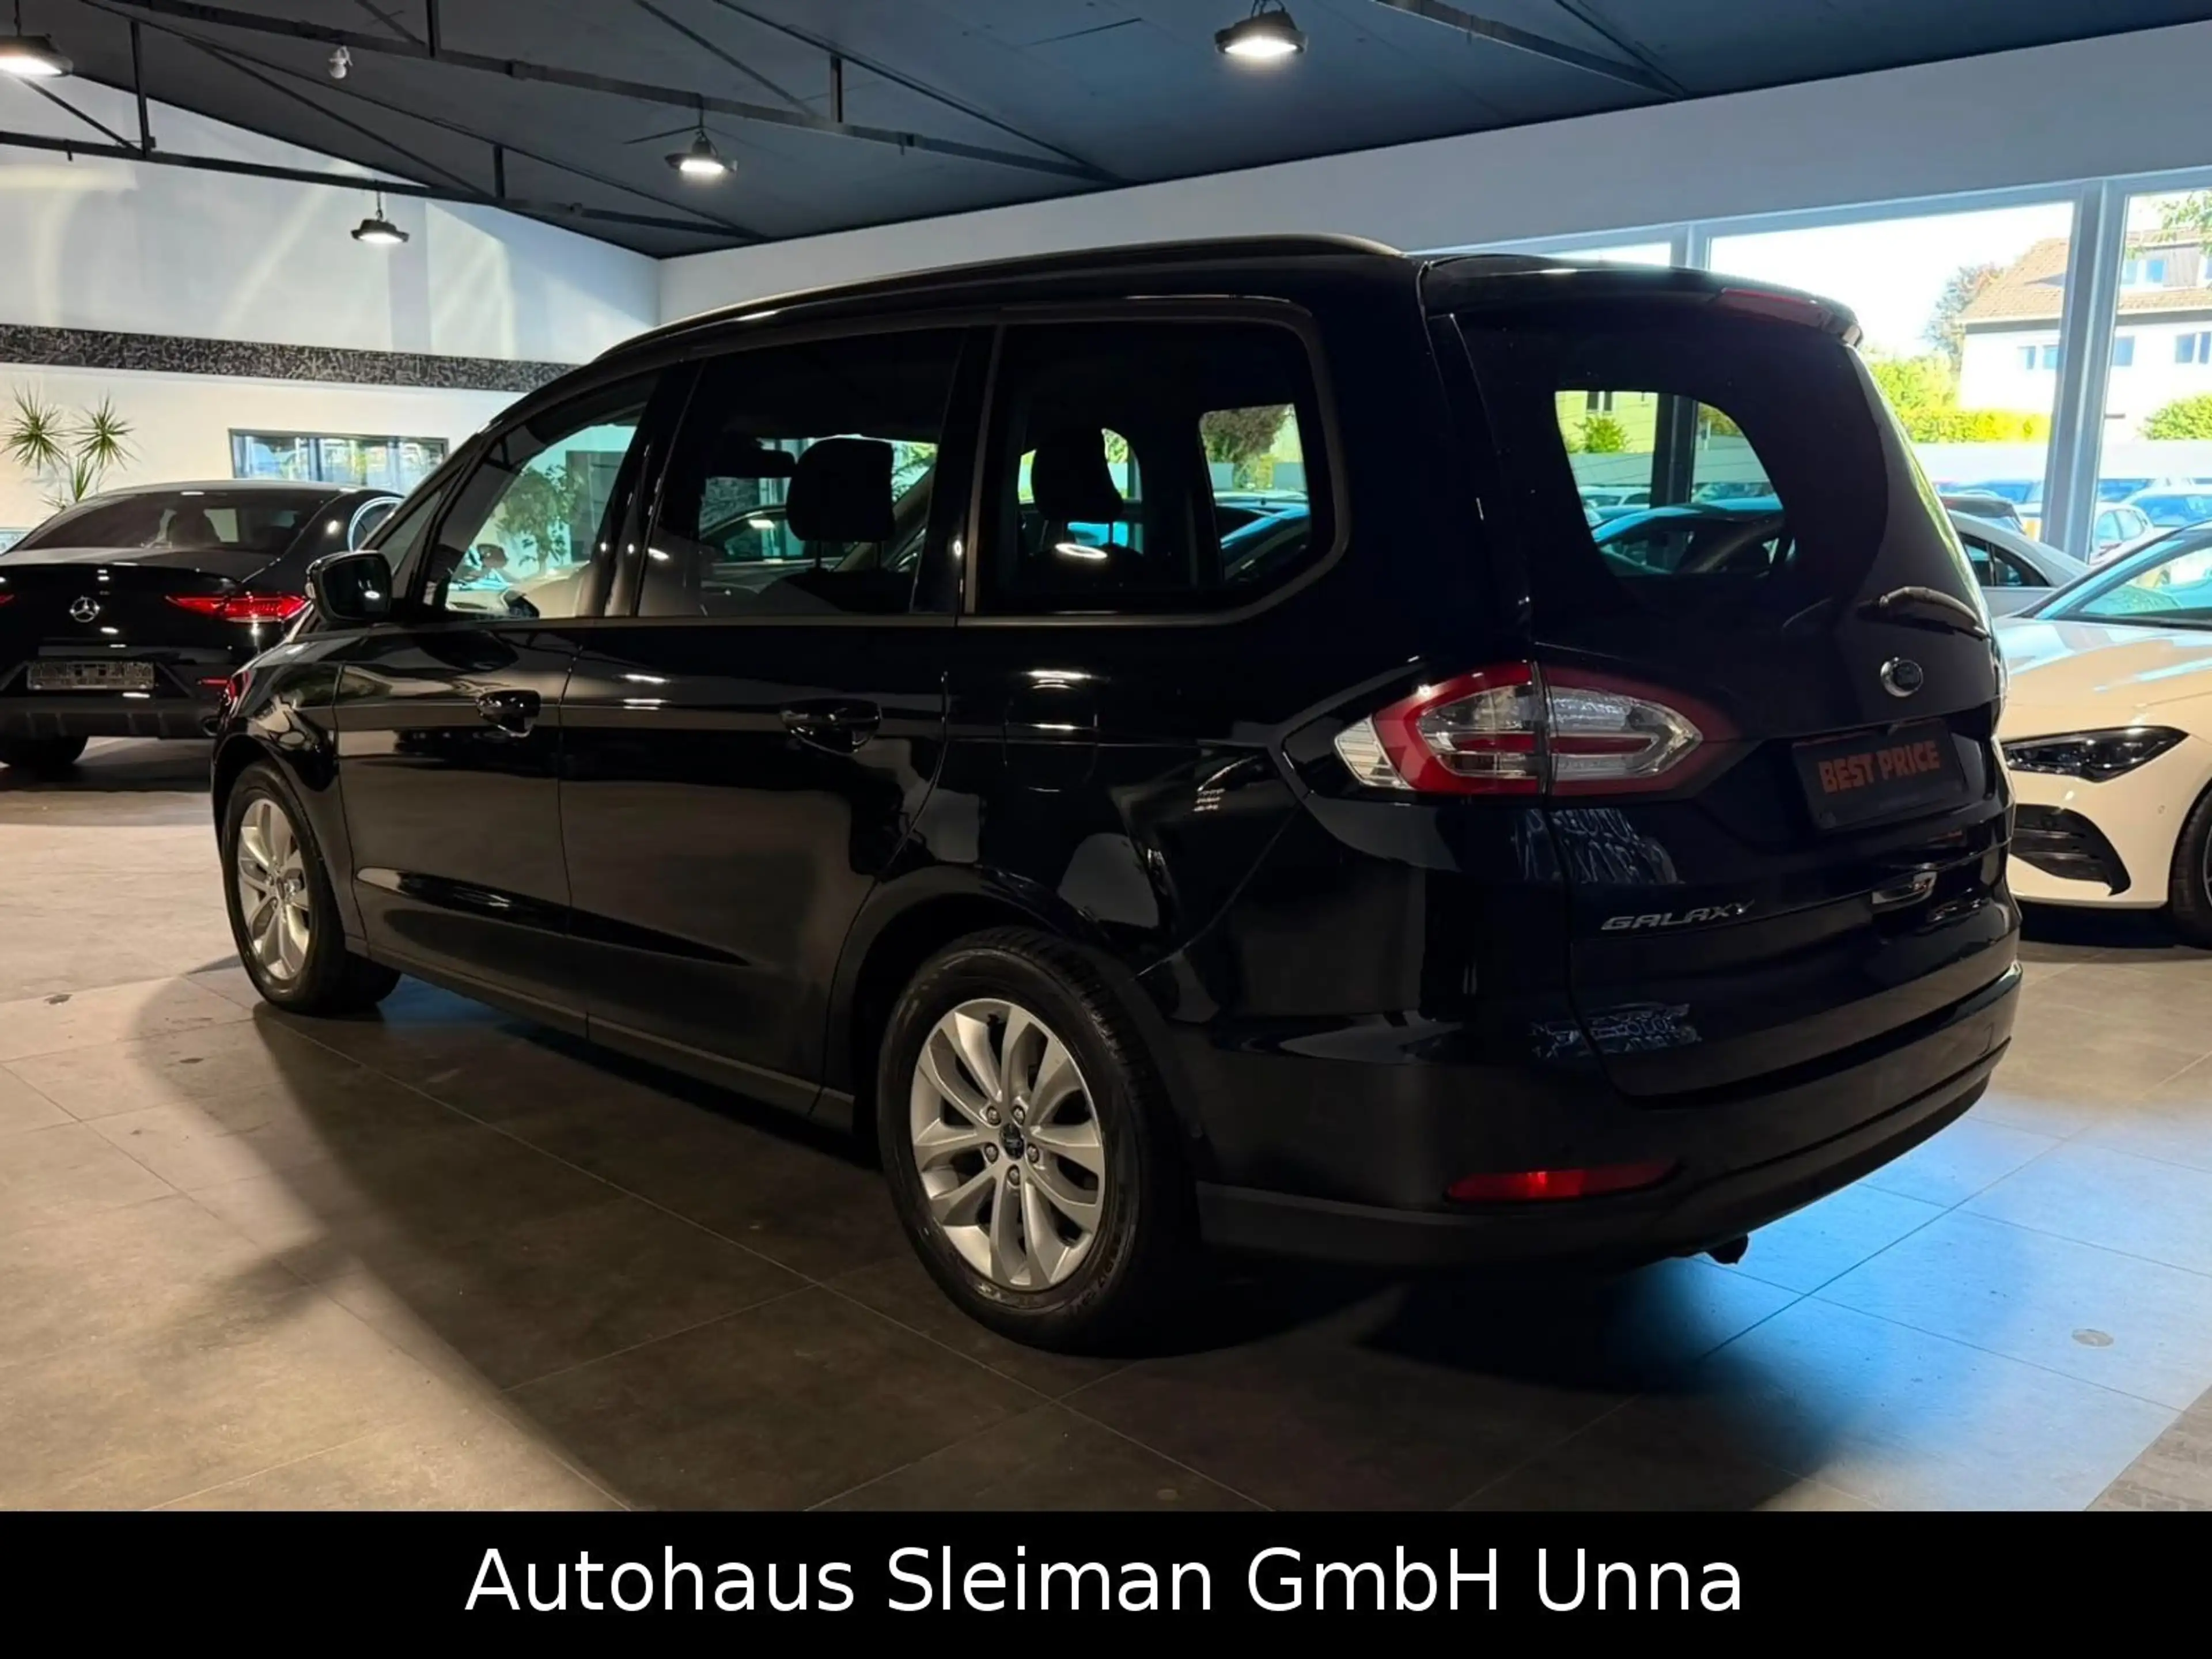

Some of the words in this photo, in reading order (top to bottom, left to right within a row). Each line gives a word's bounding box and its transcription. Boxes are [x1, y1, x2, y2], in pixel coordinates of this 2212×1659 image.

[1818, 752, 1874, 794] BEST
[1876, 740, 1941, 781] PRICE
[1600, 898, 1755, 931] GALAXY
